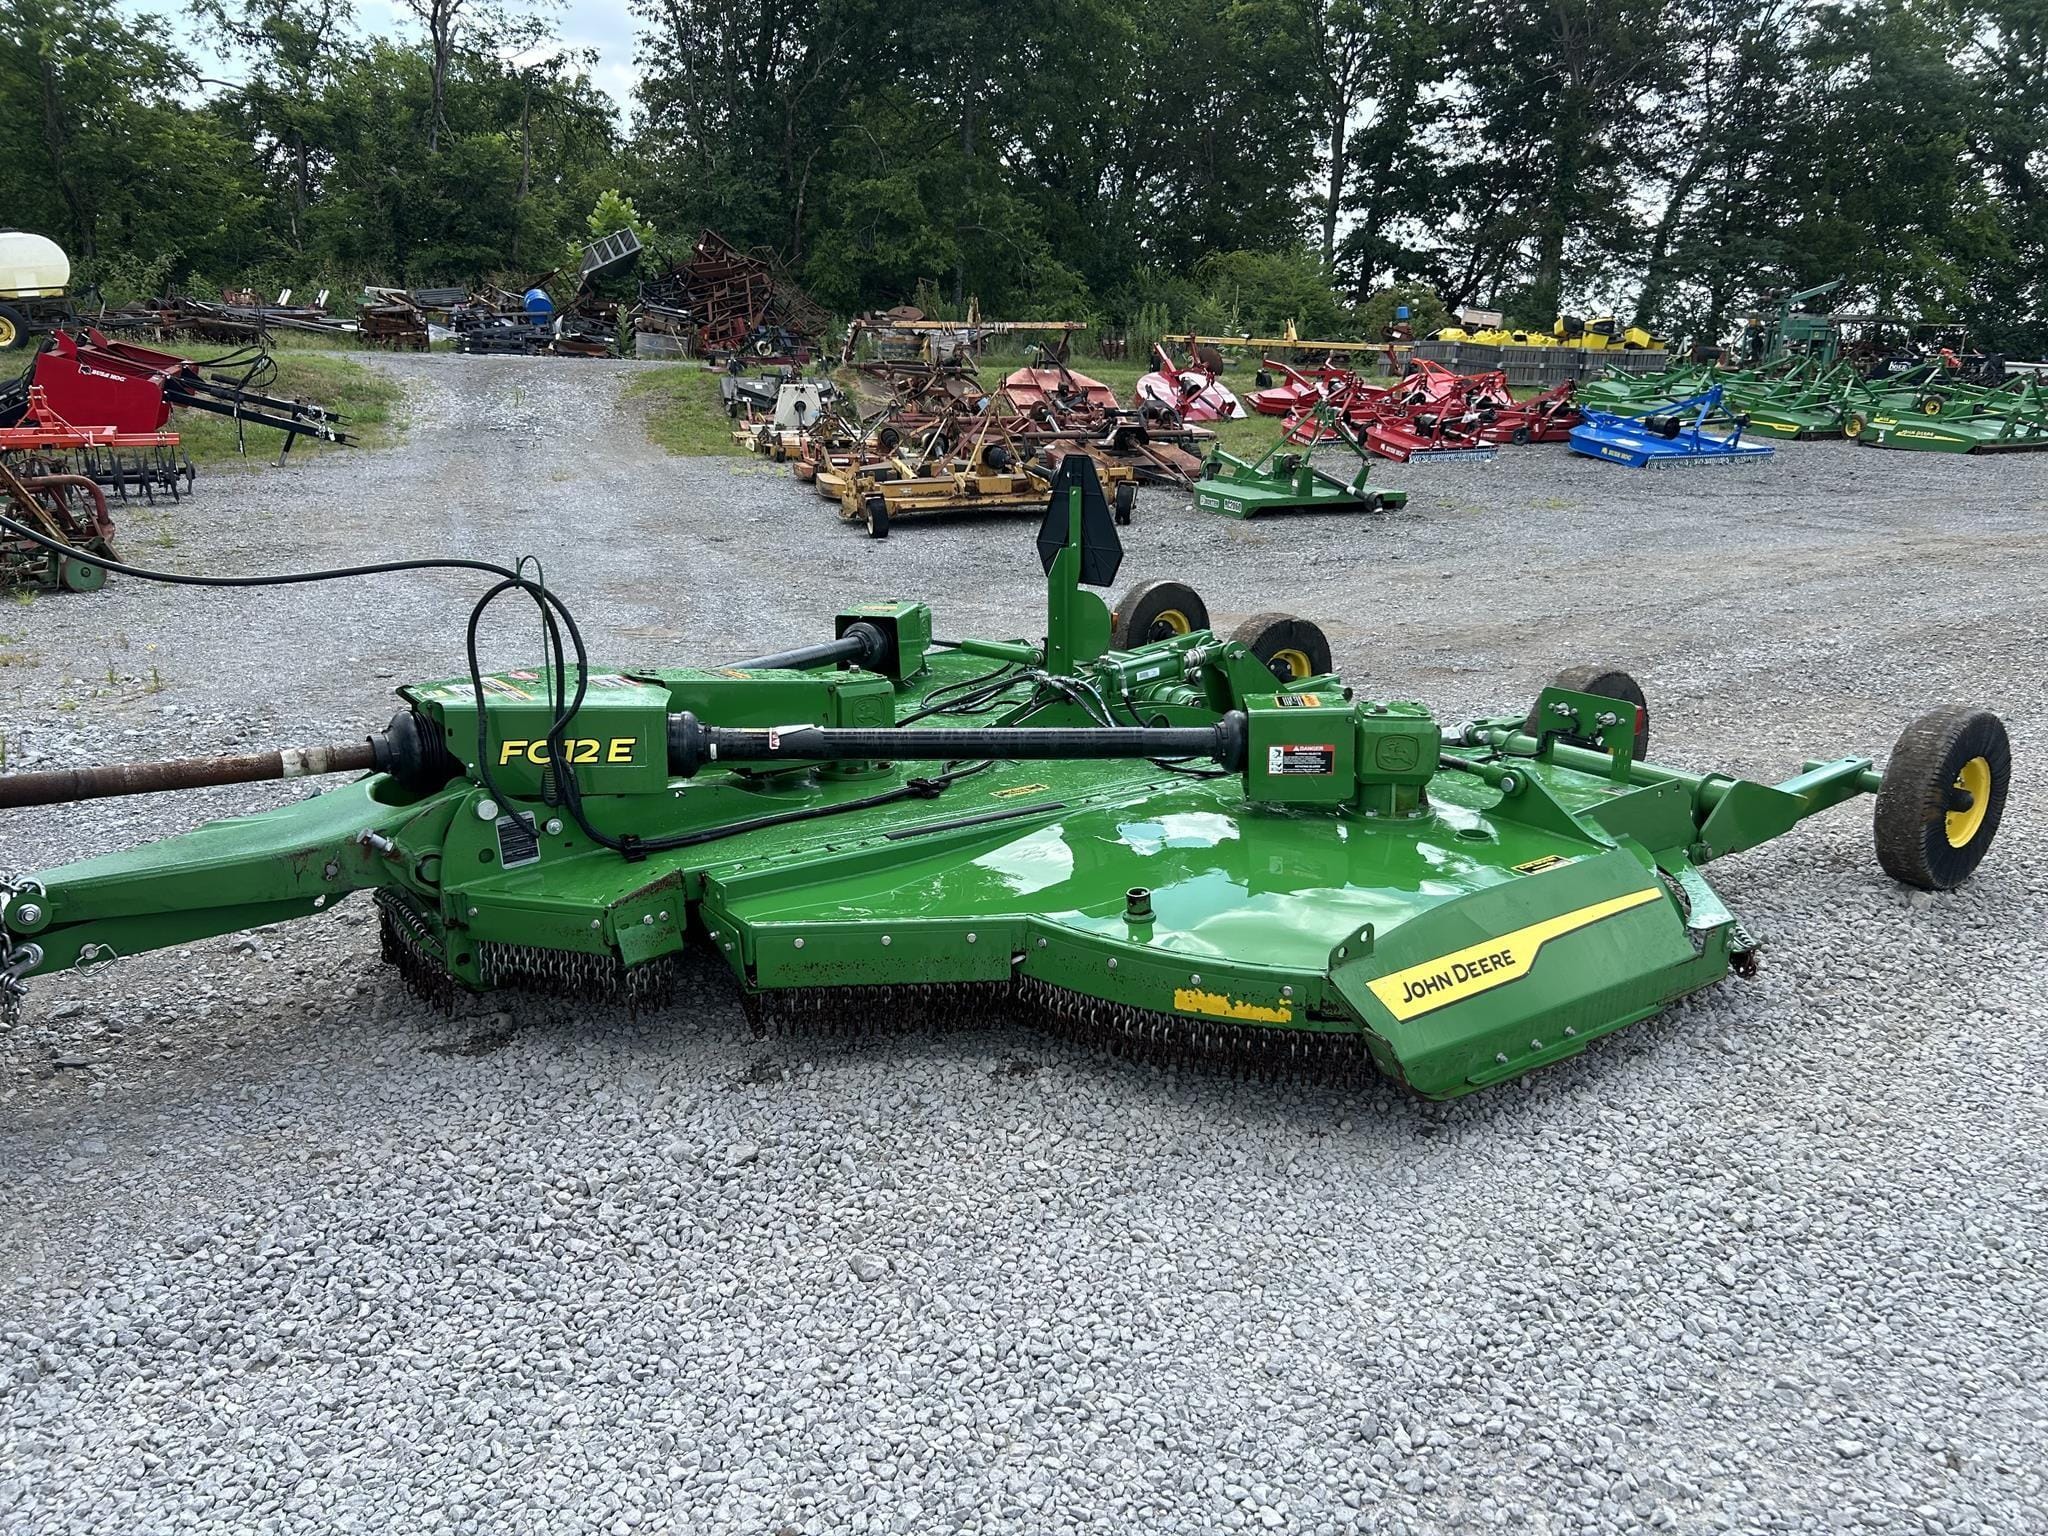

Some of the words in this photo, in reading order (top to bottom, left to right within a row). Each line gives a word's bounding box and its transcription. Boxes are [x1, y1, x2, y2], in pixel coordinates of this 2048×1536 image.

[607, 738, 636, 763] E
[1403, 971, 1454, 1004] JOHN
[1451, 949, 1517, 984] DEERE
